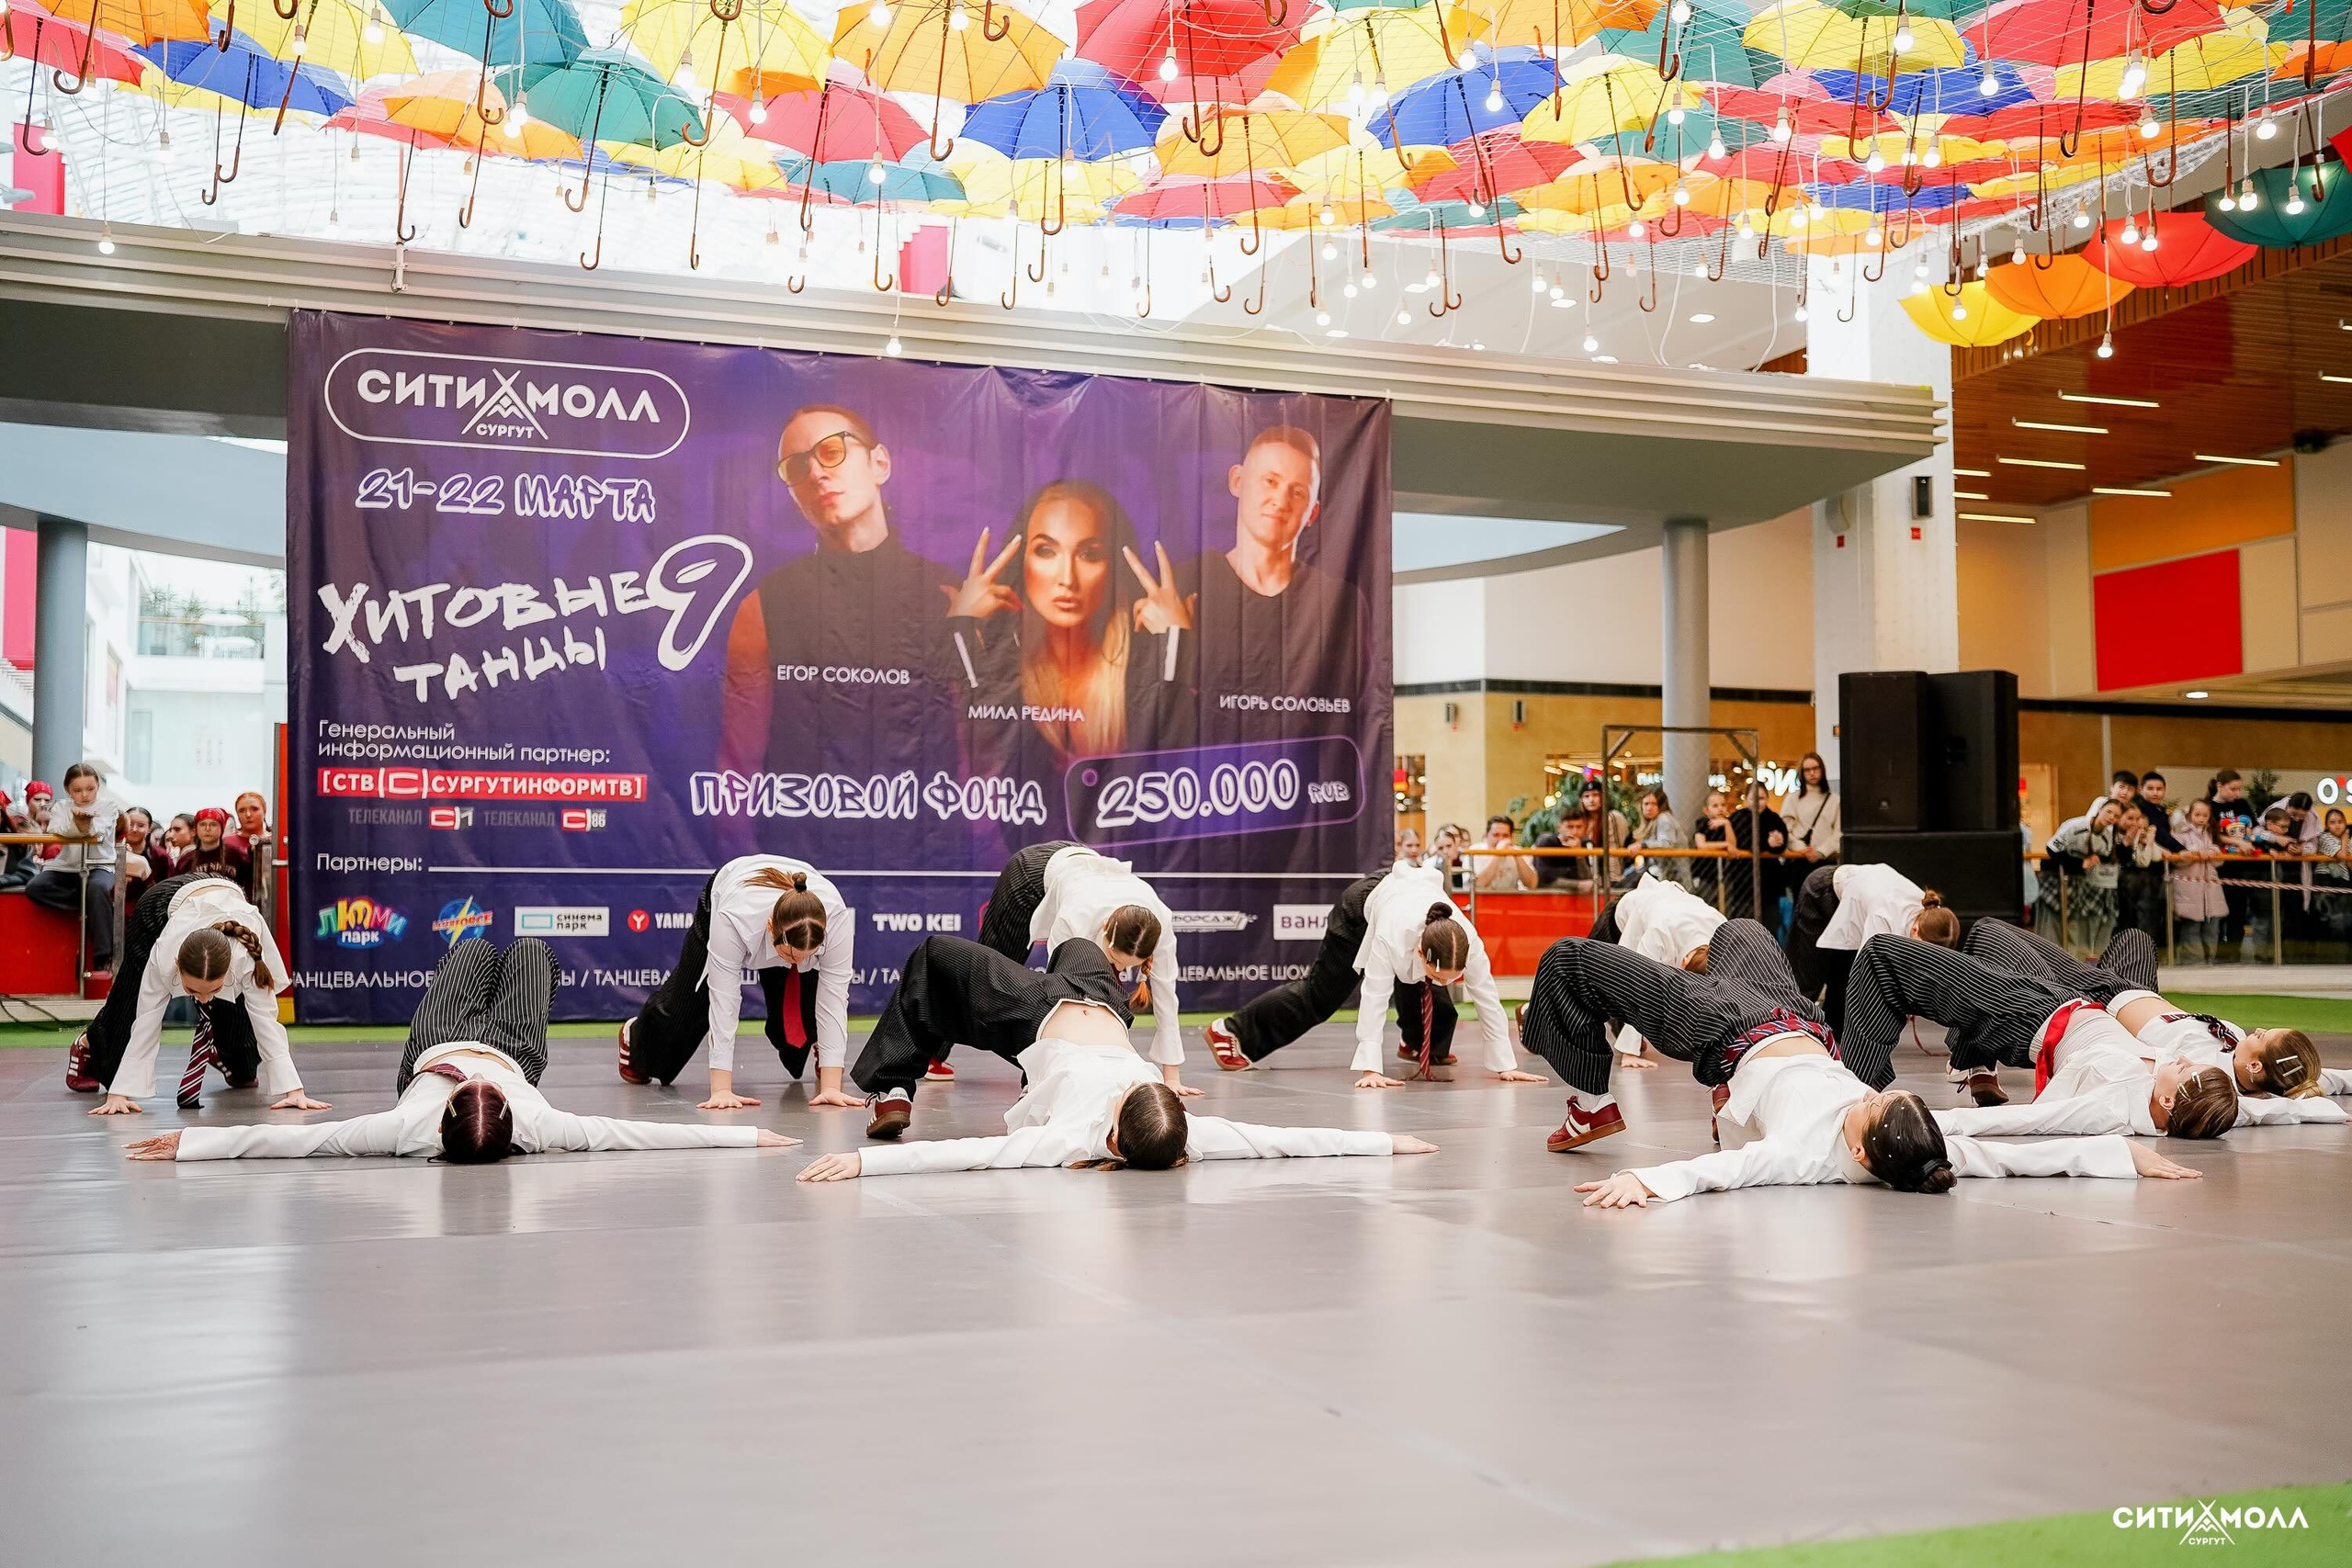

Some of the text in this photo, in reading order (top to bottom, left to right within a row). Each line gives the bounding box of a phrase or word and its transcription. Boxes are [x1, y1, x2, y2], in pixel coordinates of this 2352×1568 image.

[356, 370, 661, 424] СИТИ МОЛЛ
[476, 423, 535, 439] СУРГУТ
[355, 468, 657, 524] 21-22 МАРТА
[317, 571, 650, 663] ХИТОВЫЕ
[393, 626, 607, 703] ТАНЦЫ
[777, 664, 910, 685] ЕГОР СОКОЛОВ
[967, 705, 1085, 723] МИЛА РЕДИНА
[1219, 694, 1351, 713] ИГОРЬ СОЛОВЬЕВ
[319, 720, 456, 741] Генеральный
[319, 739, 611, 766] информационный партнер:
[689, 769, 1047, 826] ПРИЗОВОЙ ФОНД
[1095, 758, 1351, 829] 250.000 RUB
[348, 807, 422, 825] ТЕЛЕКАНАЛ
[484, 810, 556, 827] ТЕЛЕКАНАЛ
[317, 853, 423, 874] Партнеры:
[317, 897, 409, 938] ЛЮМИ
[557, 913, 603, 921] синема
[557, 921, 587, 932] парк
[873, 913, 962, 931] TWO KEI
[341, 930, 379, 946] парк
